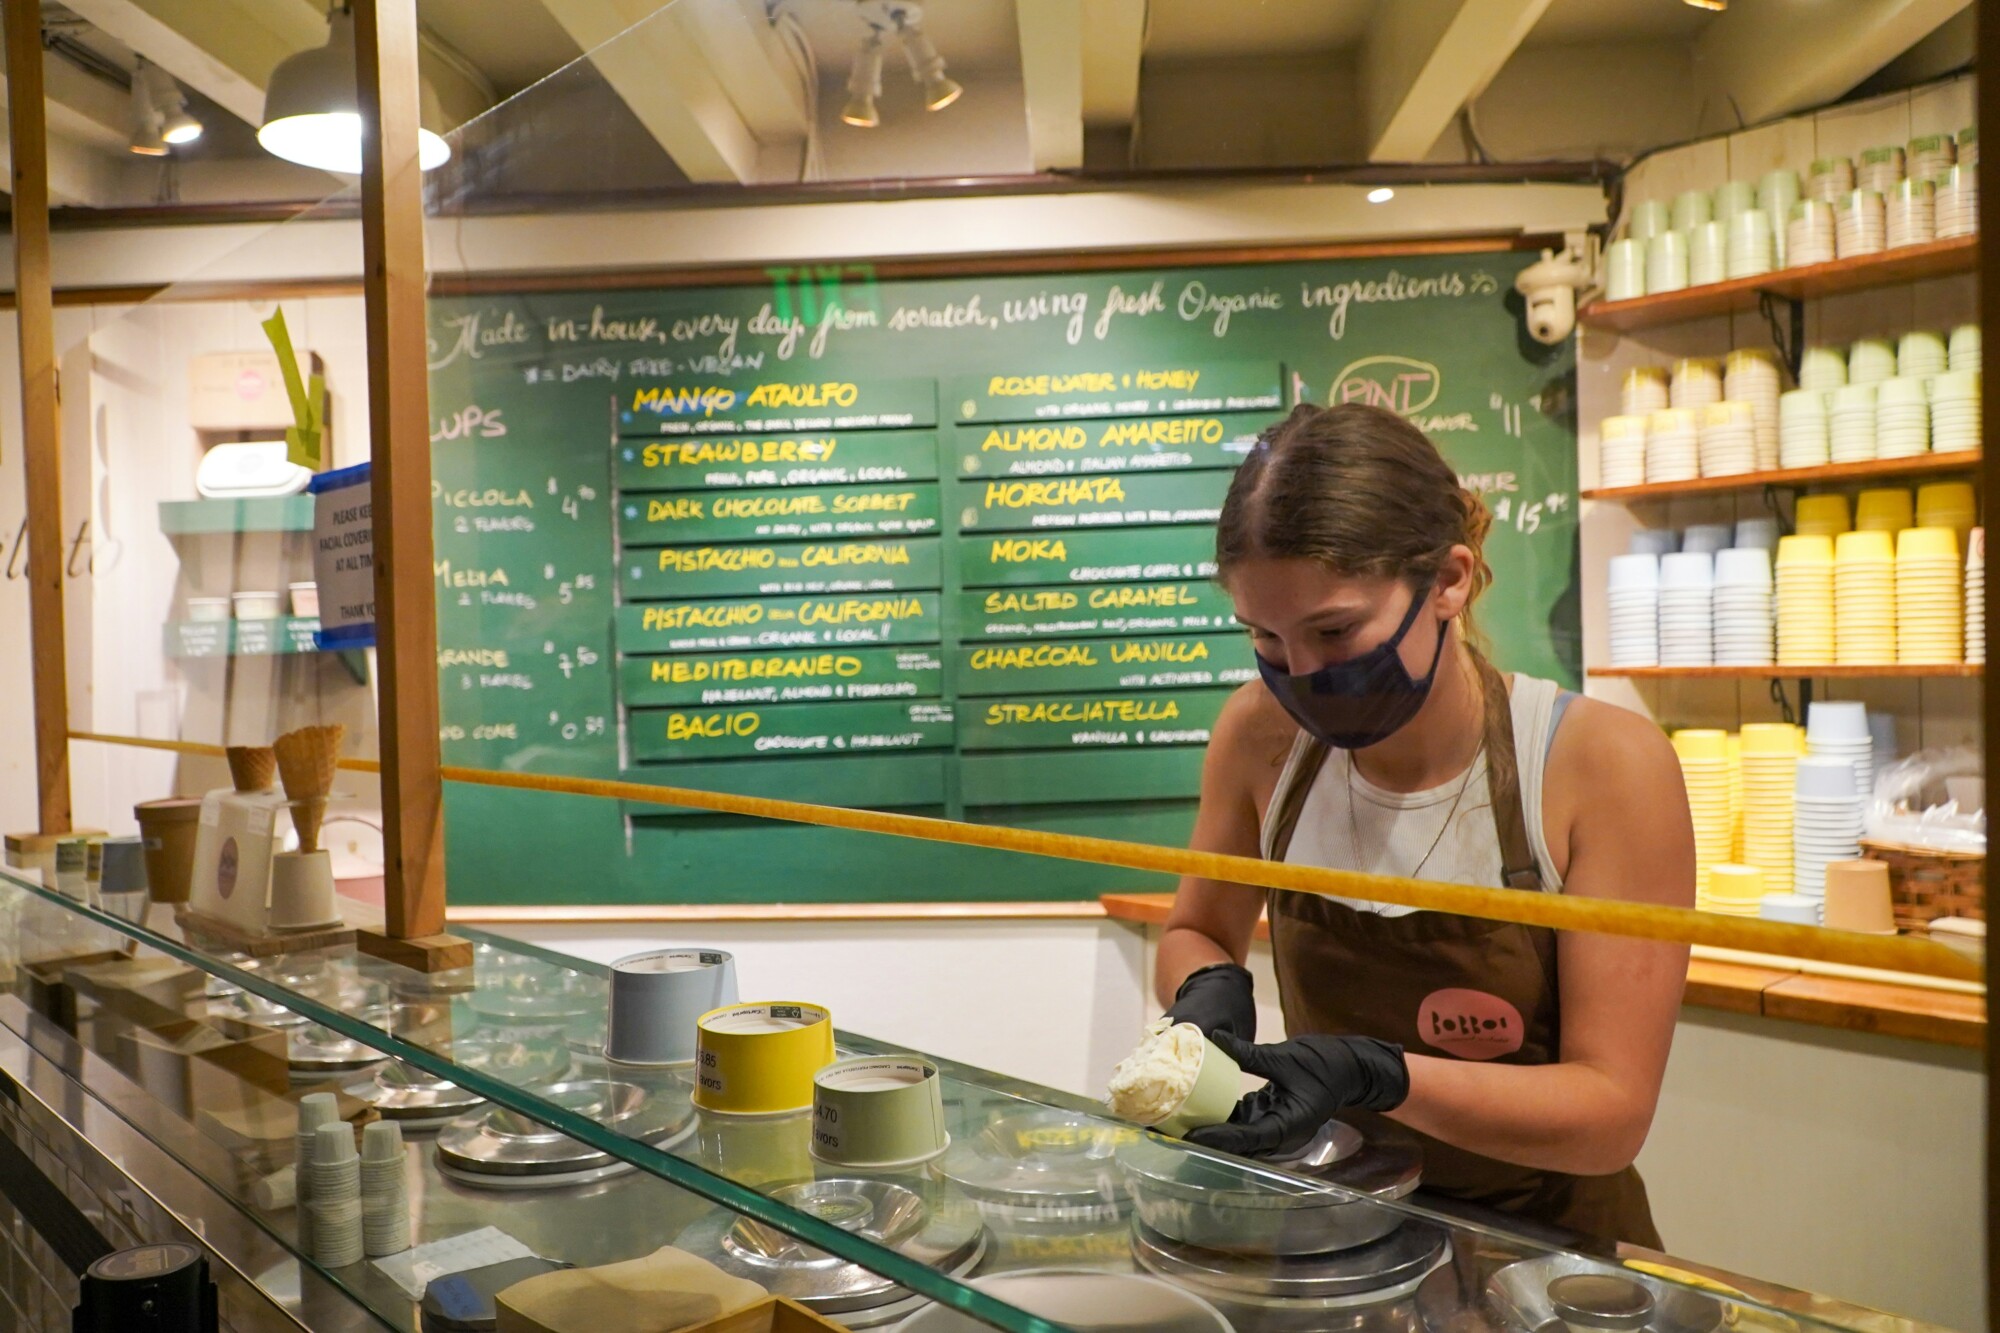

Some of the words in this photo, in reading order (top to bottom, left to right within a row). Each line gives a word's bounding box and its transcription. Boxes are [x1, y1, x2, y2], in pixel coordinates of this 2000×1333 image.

[432, 311, 528, 364] Made
[548, 304, 666, 345] in-house,
[671, 314, 739, 362] every
[809, 301, 879, 360] from
[888, 294, 998, 331] scratch,
[1003, 291, 1088, 345] using
[1094, 278, 1166, 340] fresh
[1178, 280, 1283, 338] Organic
[1301, 269, 1465, 341] ingredients
[1136, 370, 1200, 392] HONEY
[1342, 373, 1430, 413] PINT
[632, 386, 736, 417] MANGO
[746, 382, 858, 409] ATAULFO
[430, 405, 507, 442] UPS
[982, 425, 1087, 452] ALMOND
[1100, 419, 1224, 447] AMARETTO
[642, 438, 837, 468] STRAWBERRY
[646, 499, 705, 522] DARK
[712, 495, 827, 519] CHOCOLATE
[830, 493, 916, 515] SORBET
[984, 477, 1126, 509] HORCHATA
[333, 505, 358, 525] PLEASE
[319, 536, 343, 551] FACIAL
[990, 539, 1067, 563] MOKA
[335, 558, 345, 573] AT
[346, 556, 359, 571] ALL
[659, 547, 775, 573] PISTACCHIO
[800, 544, 911, 567] CALIFORNIA
[340, 605, 365, 619] THANK
[642, 603, 763, 631] PISTACCHIO
[798, 598, 924, 626] CALIFORNIA
[984, 592, 1078, 615] SALTED
[1089, 585, 1198, 609] CARAMEL
[437, 648, 509, 669] RANDE
[652, 654, 862, 683] MEDITERRANEO
[970, 645, 1098, 670] CHARCOAL
[667, 711, 760, 740] BACIO
[984, 700, 1180, 725] STRACCIATELLA
